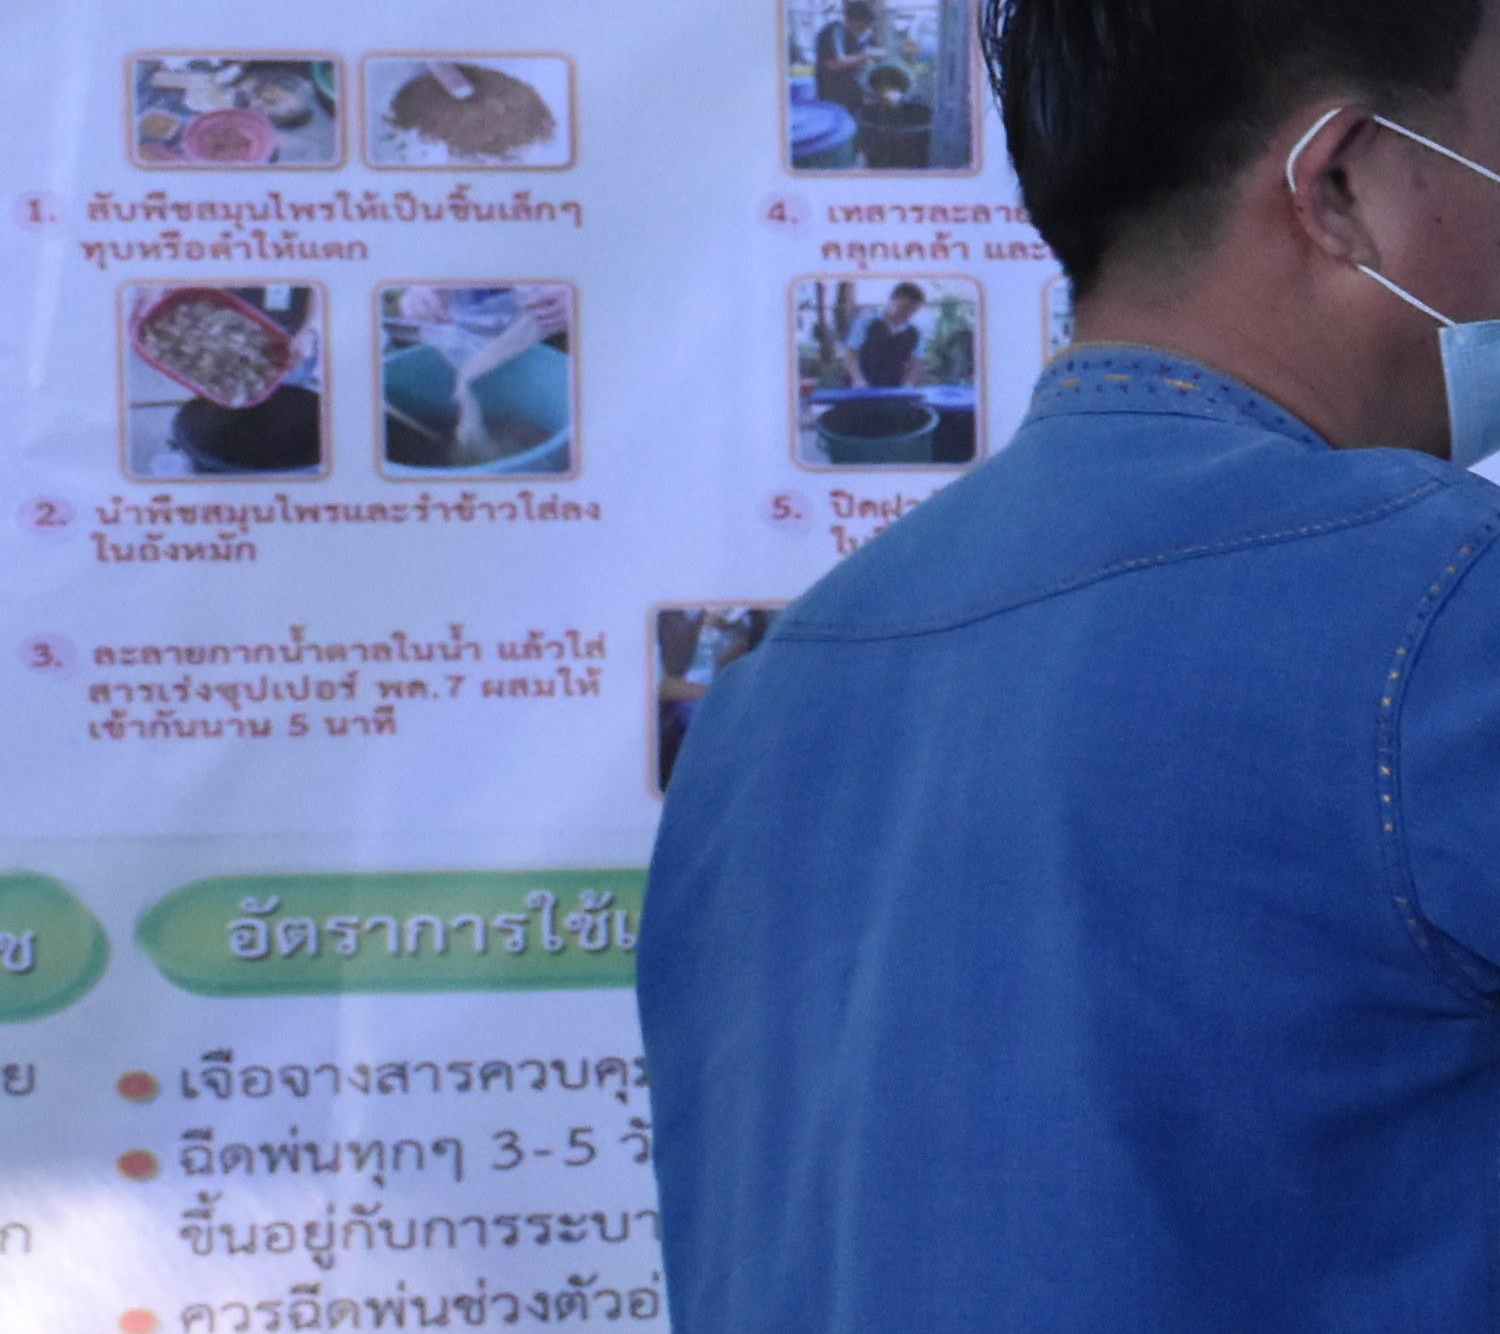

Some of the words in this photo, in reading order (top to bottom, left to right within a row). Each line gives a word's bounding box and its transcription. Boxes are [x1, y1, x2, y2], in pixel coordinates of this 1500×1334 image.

[287, 712, 311, 739] 5
[227, 891, 637, 959] อัตราการใช้เ
[179, 1124, 465, 1188] ฉีดพ่นทุกๆ
[491, 1125, 598, 1172] 3-5
[180, 1191, 661, 1270] ขึ้นอยู่กับการระบา
